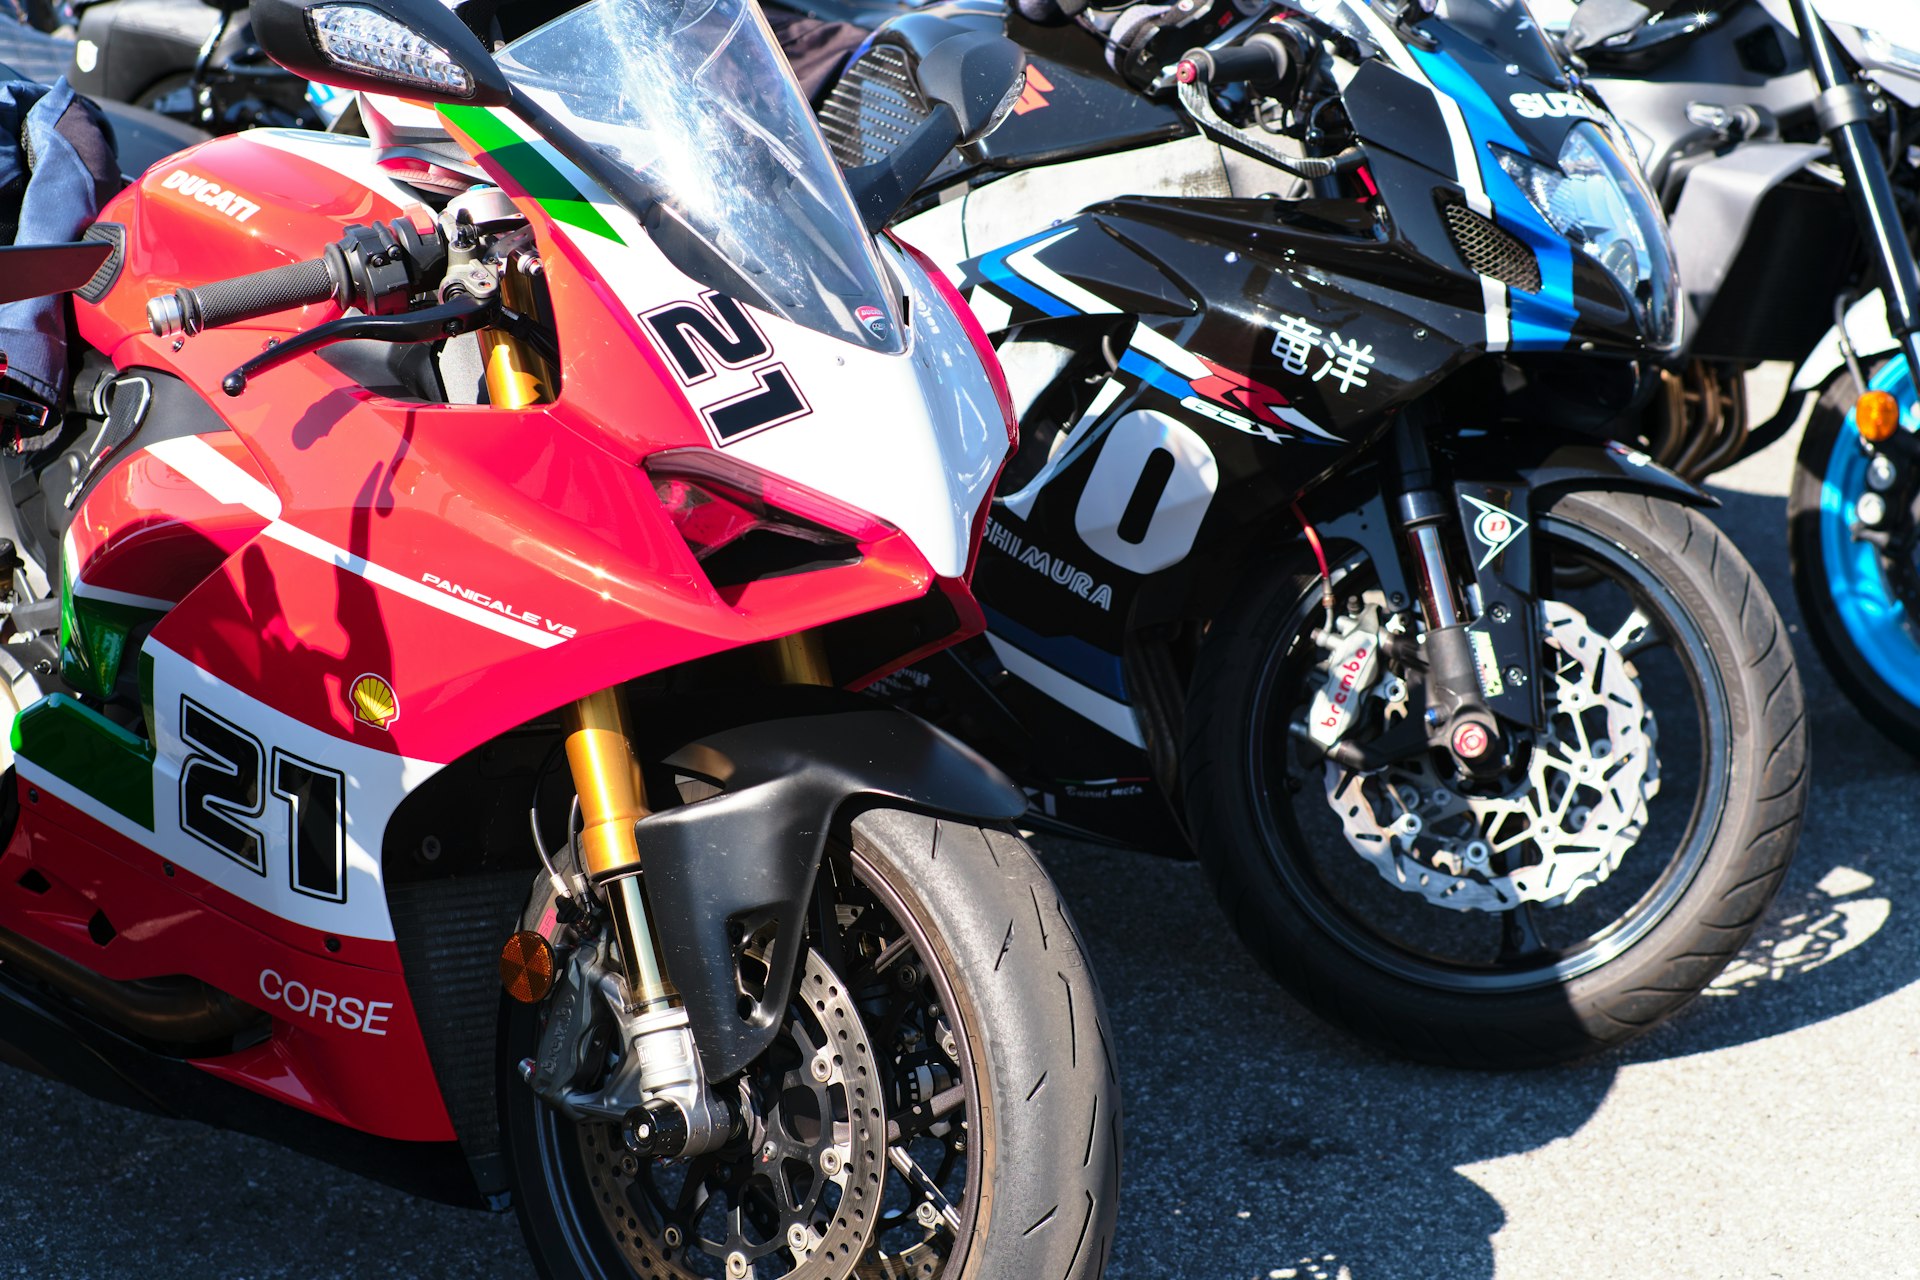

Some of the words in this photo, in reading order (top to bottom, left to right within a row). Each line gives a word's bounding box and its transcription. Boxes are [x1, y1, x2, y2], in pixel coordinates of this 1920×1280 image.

[161, 169, 261, 222] DUCATI
[637, 288, 813, 448] 21
[1271, 314, 1375, 393] 竜洋
[1180, 395, 1295, 445] GSX
[421, 572, 542, 626] PANIGALE
[545, 618, 577, 639] V2
[1320, 647, 1367, 728] brembo
[178, 692, 347, 905] 21
[259, 968, 394, 1036] CORSE
